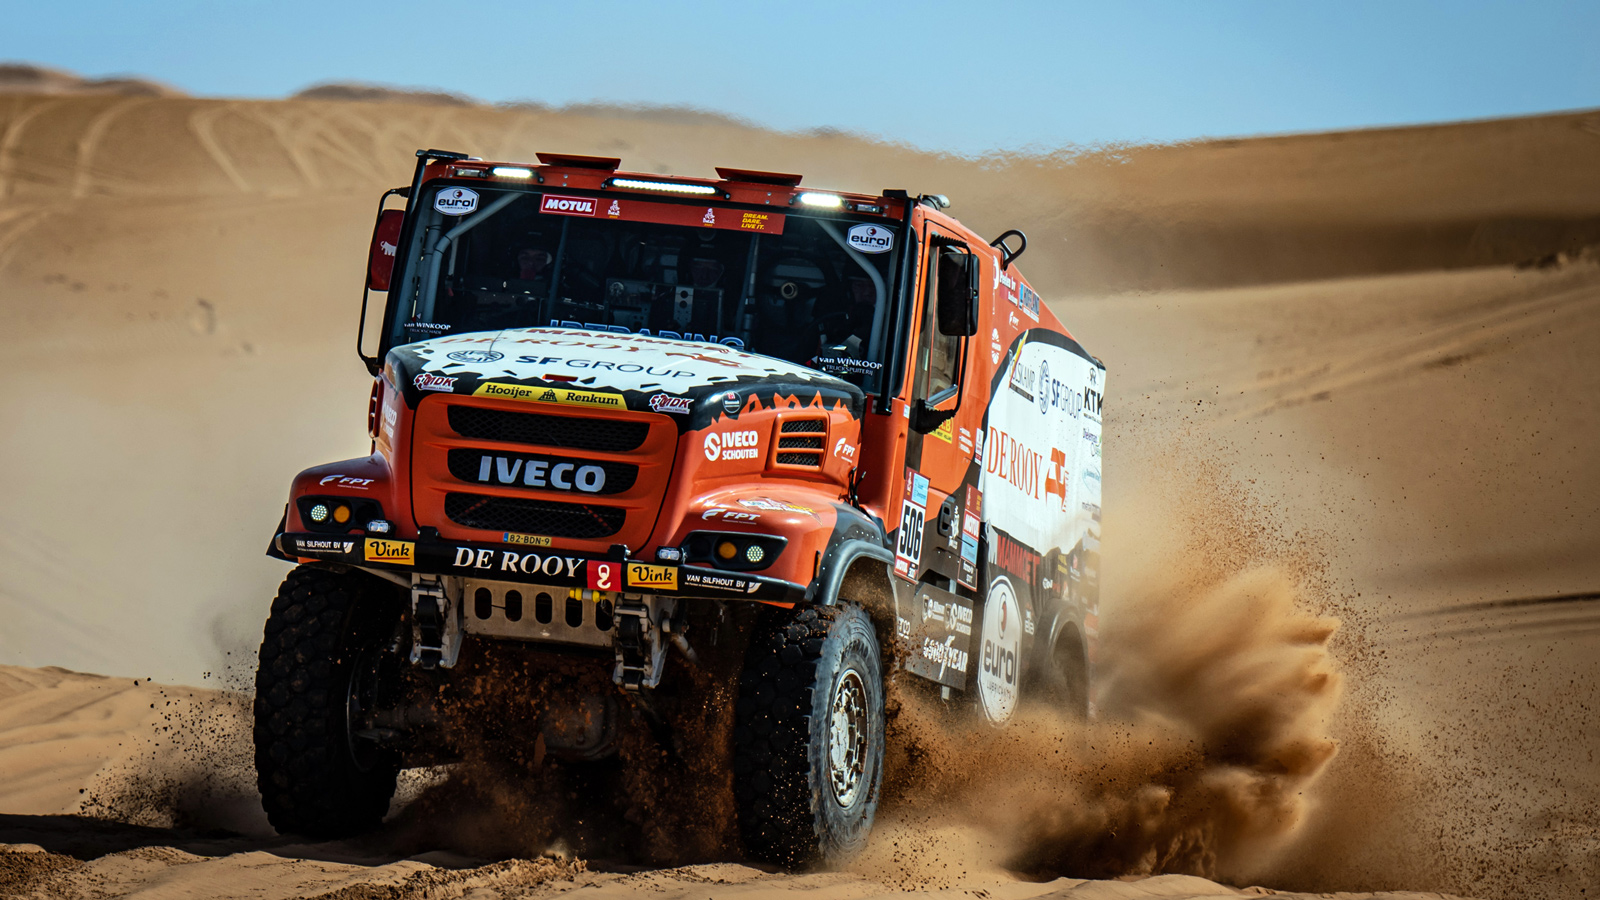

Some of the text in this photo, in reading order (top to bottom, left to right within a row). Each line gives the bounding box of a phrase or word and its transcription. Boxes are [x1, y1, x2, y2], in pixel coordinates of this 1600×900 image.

[437, 197, 475, 208] eurol
[545, 198, 593, 213] MOTUL
[743, 212, 769, 221] DREAM.
[851, 234, 890, 247] eurol
[416, 322, 452, 331] WINKOOP
[819, 356, 883, 370] van WINKOOP
[485, 384, 533, 399] Hooijer
[565, 391, 619, 406] Renkum
[722, 430, 759, 448] IVECO
[721, 448, 759, 461] SCHOUTEN
[842, 443, 856, 458] FPT
[987, 425, 1009, 480] DE
[1008, 436, 1043, 501] ROOY
[478, 455, 607, 493] IVECO
[338, 477, 375, 486] FPT
[723, 511, 761, 521] FPT
[509, 533, 551, 546] 82-BDN-9
[899, 504, 924, 561] 506
[295, 539, 341, 549] VAN SILFHOUT BV
[370, 540, 410, 557] Vink
[453, 546, 585, 578] DE ROOY
[632, 566, 673, 582] Vink
[686, 574, 700, 583] VAN
[702, 576, 735, 587] SILFHOUT
[736, 580, 746, 588] BV
[983, 638, 1019, 687] eurol
